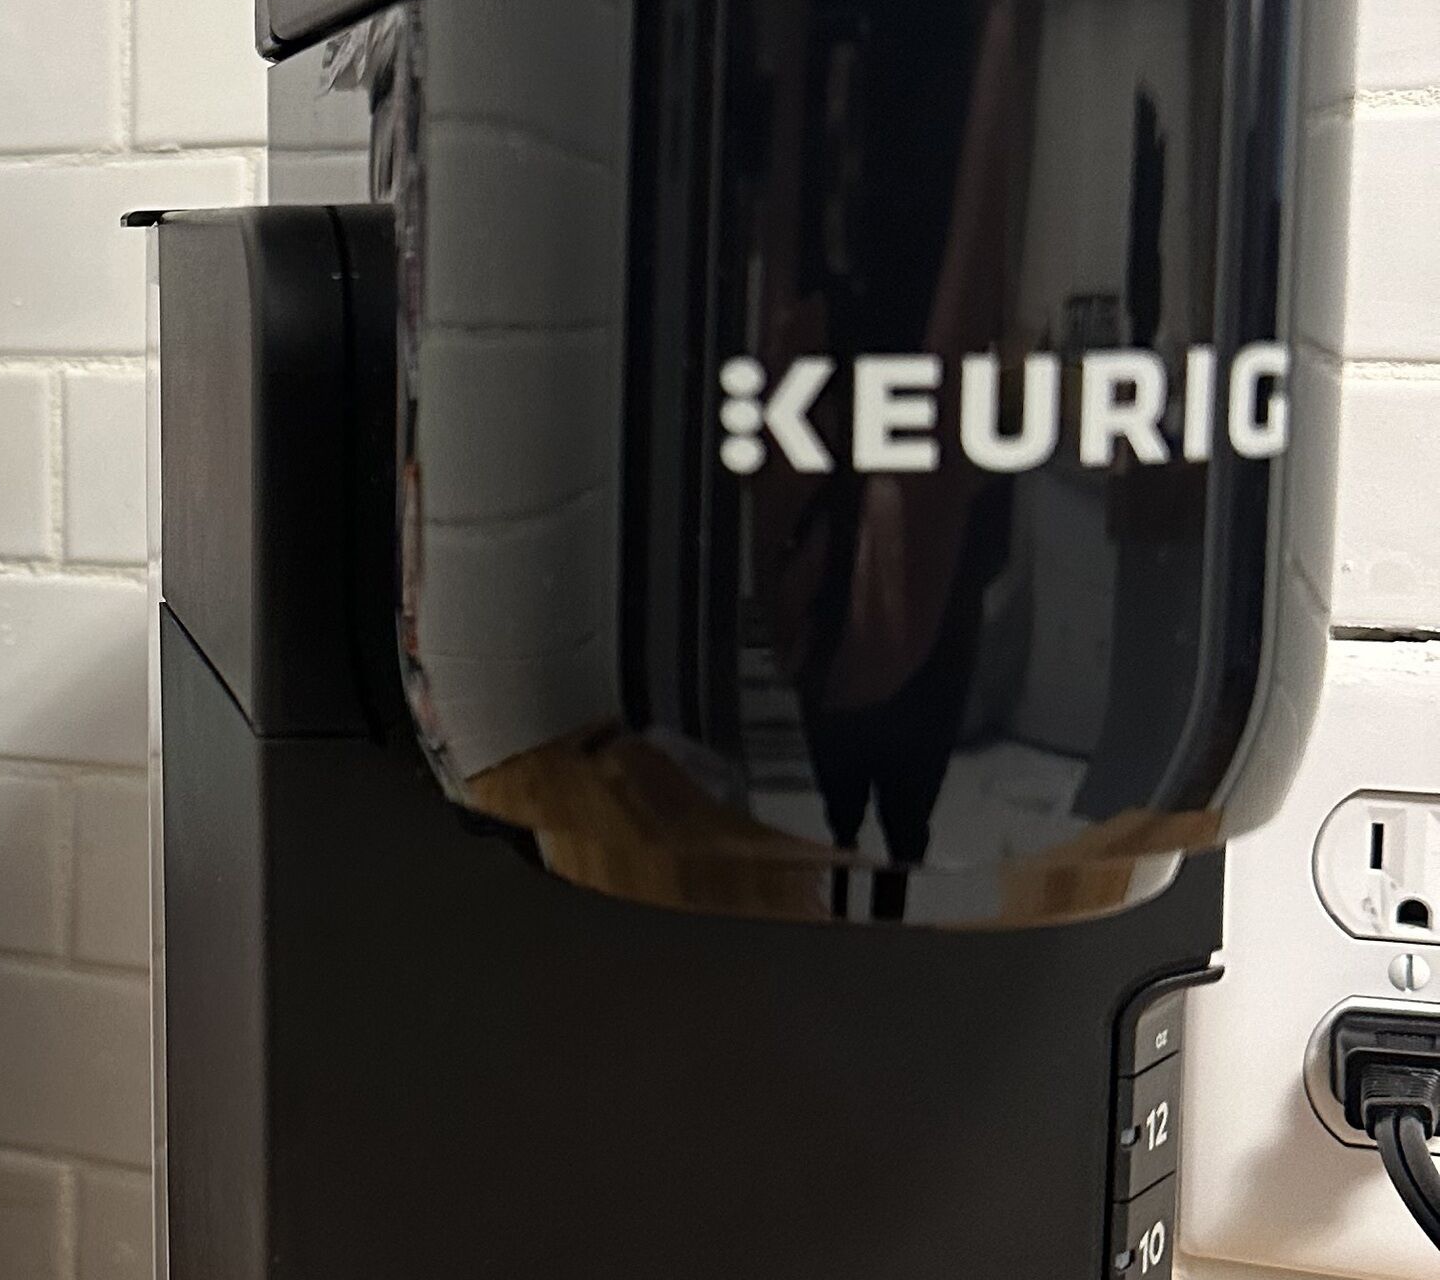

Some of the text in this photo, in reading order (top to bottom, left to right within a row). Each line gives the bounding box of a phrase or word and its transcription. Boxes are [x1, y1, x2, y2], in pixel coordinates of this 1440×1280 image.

[719, 339, 1290, 475] KEURIG
[1146, 1100, 1169, 1150] 12
[1139, 1221, 1165, 1275] 10
